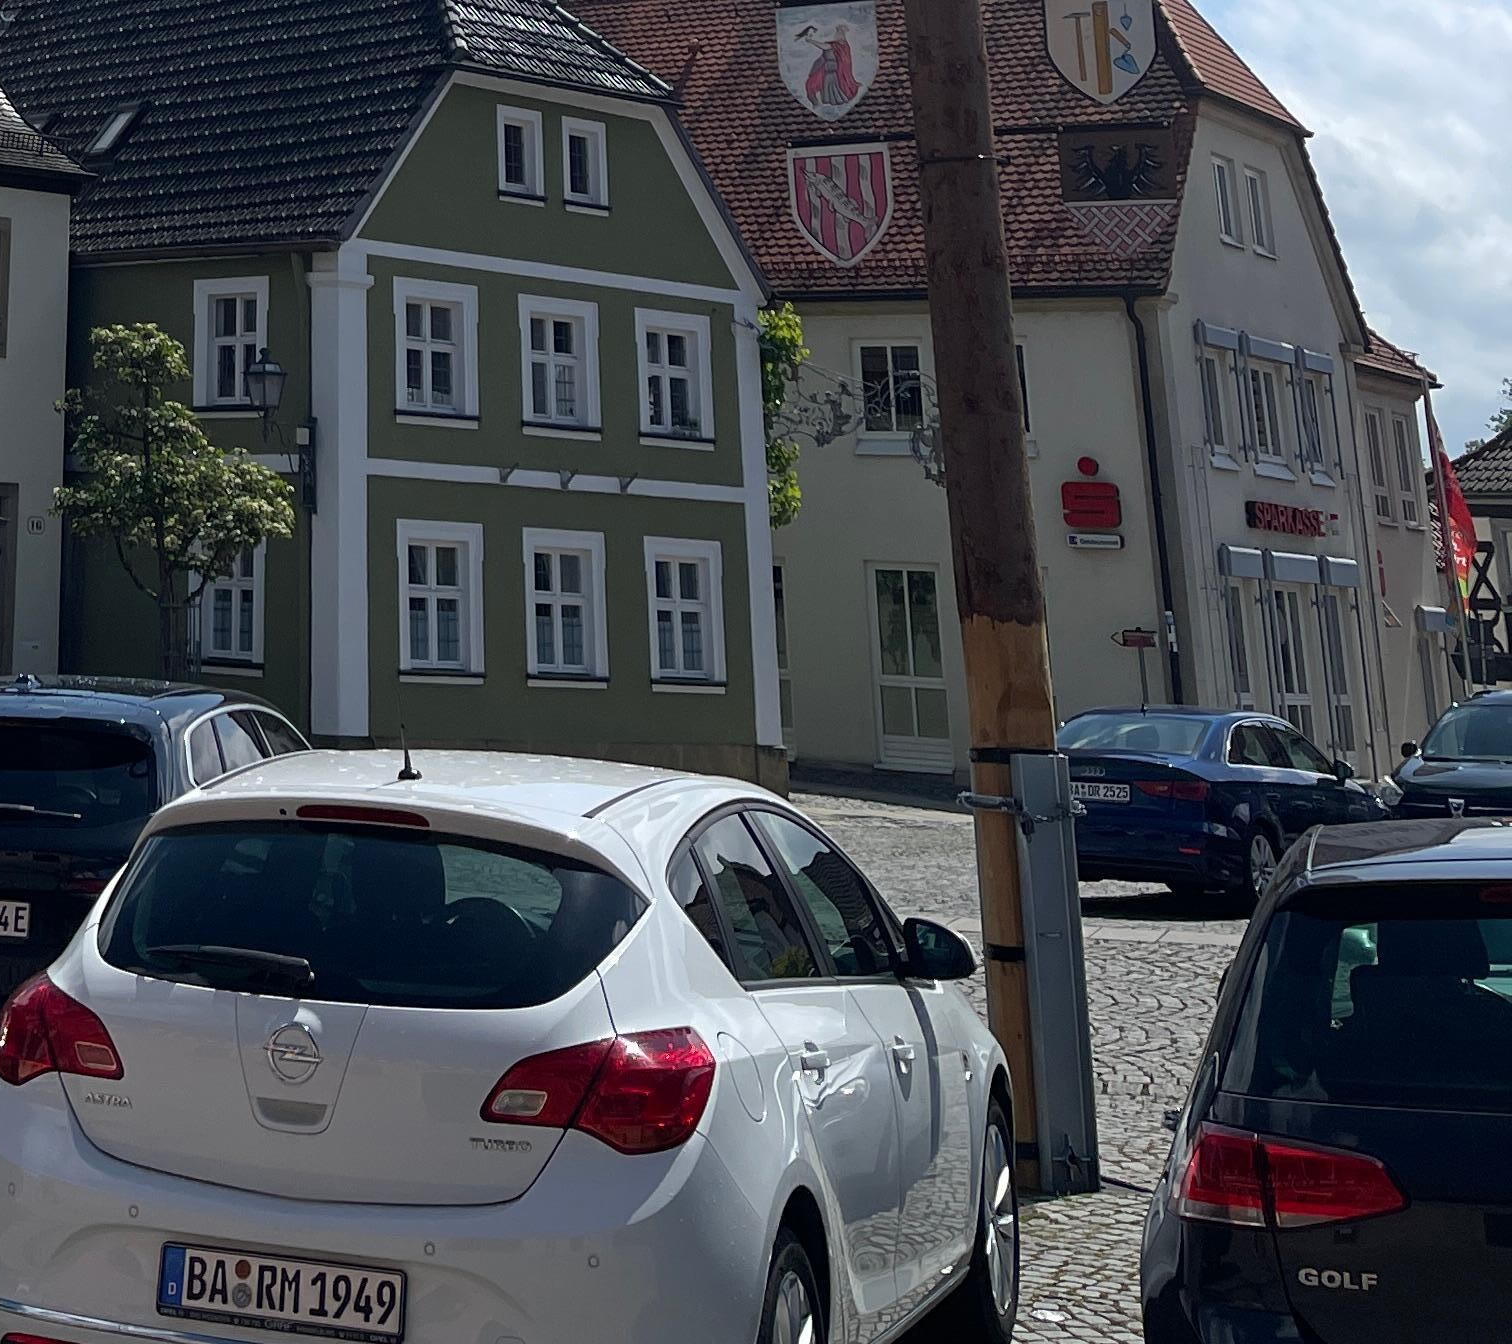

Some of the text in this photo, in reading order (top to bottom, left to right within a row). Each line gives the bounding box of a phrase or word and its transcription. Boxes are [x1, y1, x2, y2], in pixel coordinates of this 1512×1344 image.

[1254, 502, 1326, 538] SPARKASSE
[1103, 786, 1128, 799] 2525
[85, 1092, 133, 1109] ASTRA
[469, 1137, 533, 1153] TURBO
[1298, 1267, 1378, 1291] GOLF
[186, 1256, 396, 1325] BA RM 1949
